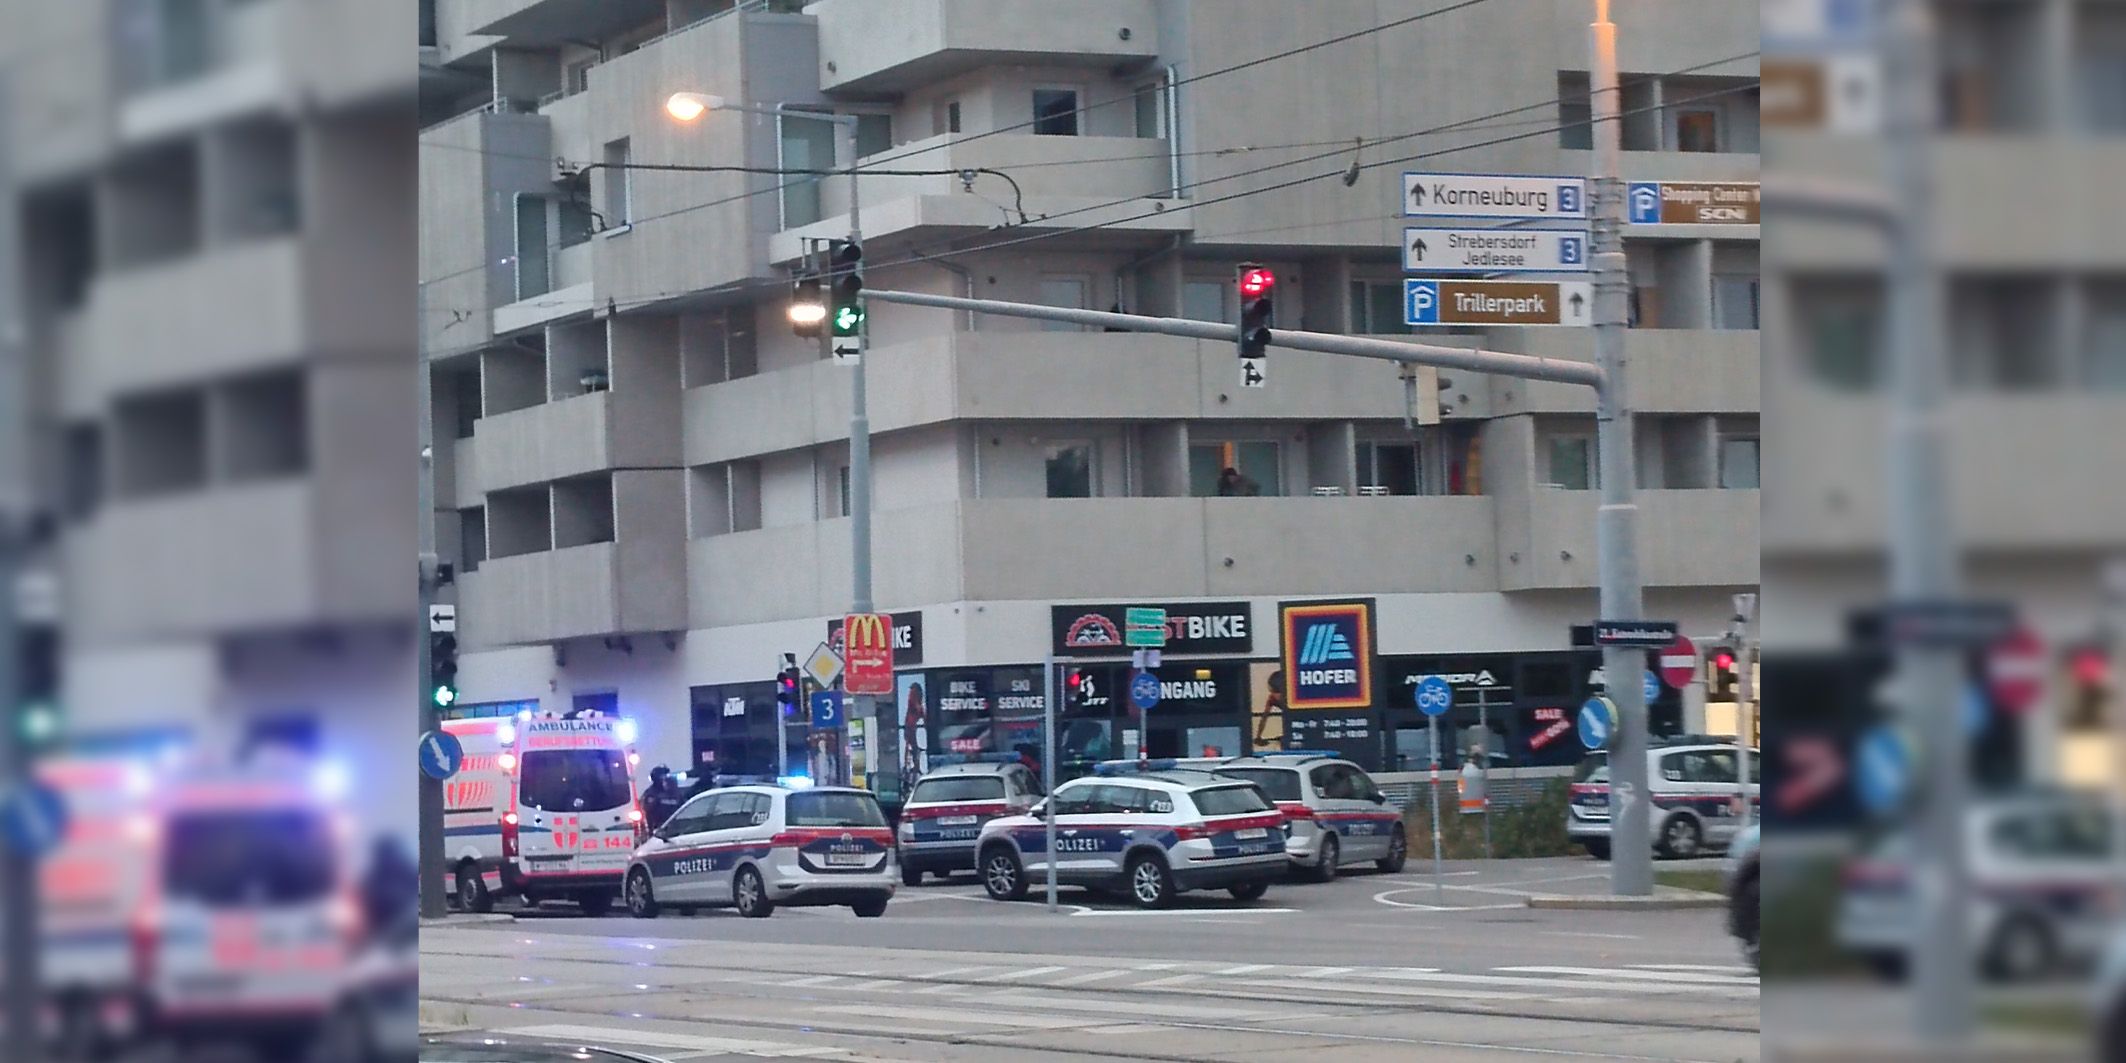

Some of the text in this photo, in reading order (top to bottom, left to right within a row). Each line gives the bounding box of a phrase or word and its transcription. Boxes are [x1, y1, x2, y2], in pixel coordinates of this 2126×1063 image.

[1433, 184, 1574, 212] Korneuburg 3
[1449, 233, 1537, 249] Strebersdorf
[1462, 251, 1525, 266] Jedlesee
[1565, 240, 1576, 262] 3
[1414, 293, 1432, 319] P
[1453, 292, 1546, 317] Trillerpark
[1300, 668, 1357, 686] HOFER
[950, 681, 977, 694] BIKE
[1011, 679, 1030, 691] SKI
[1160, 681, 1217, 699] NGANG
[822, 698, 834, 720] 3
[940, 697, 987, 711] SERVICE
[998, 695, 1044, 709] SERVICE
[951, 739, 981, 751] SALE
[604, 836, 632, 849] 144
[1056, 838, 1099, 851] OLIZEI
[674, 859, 713, 874] POLIZEI
